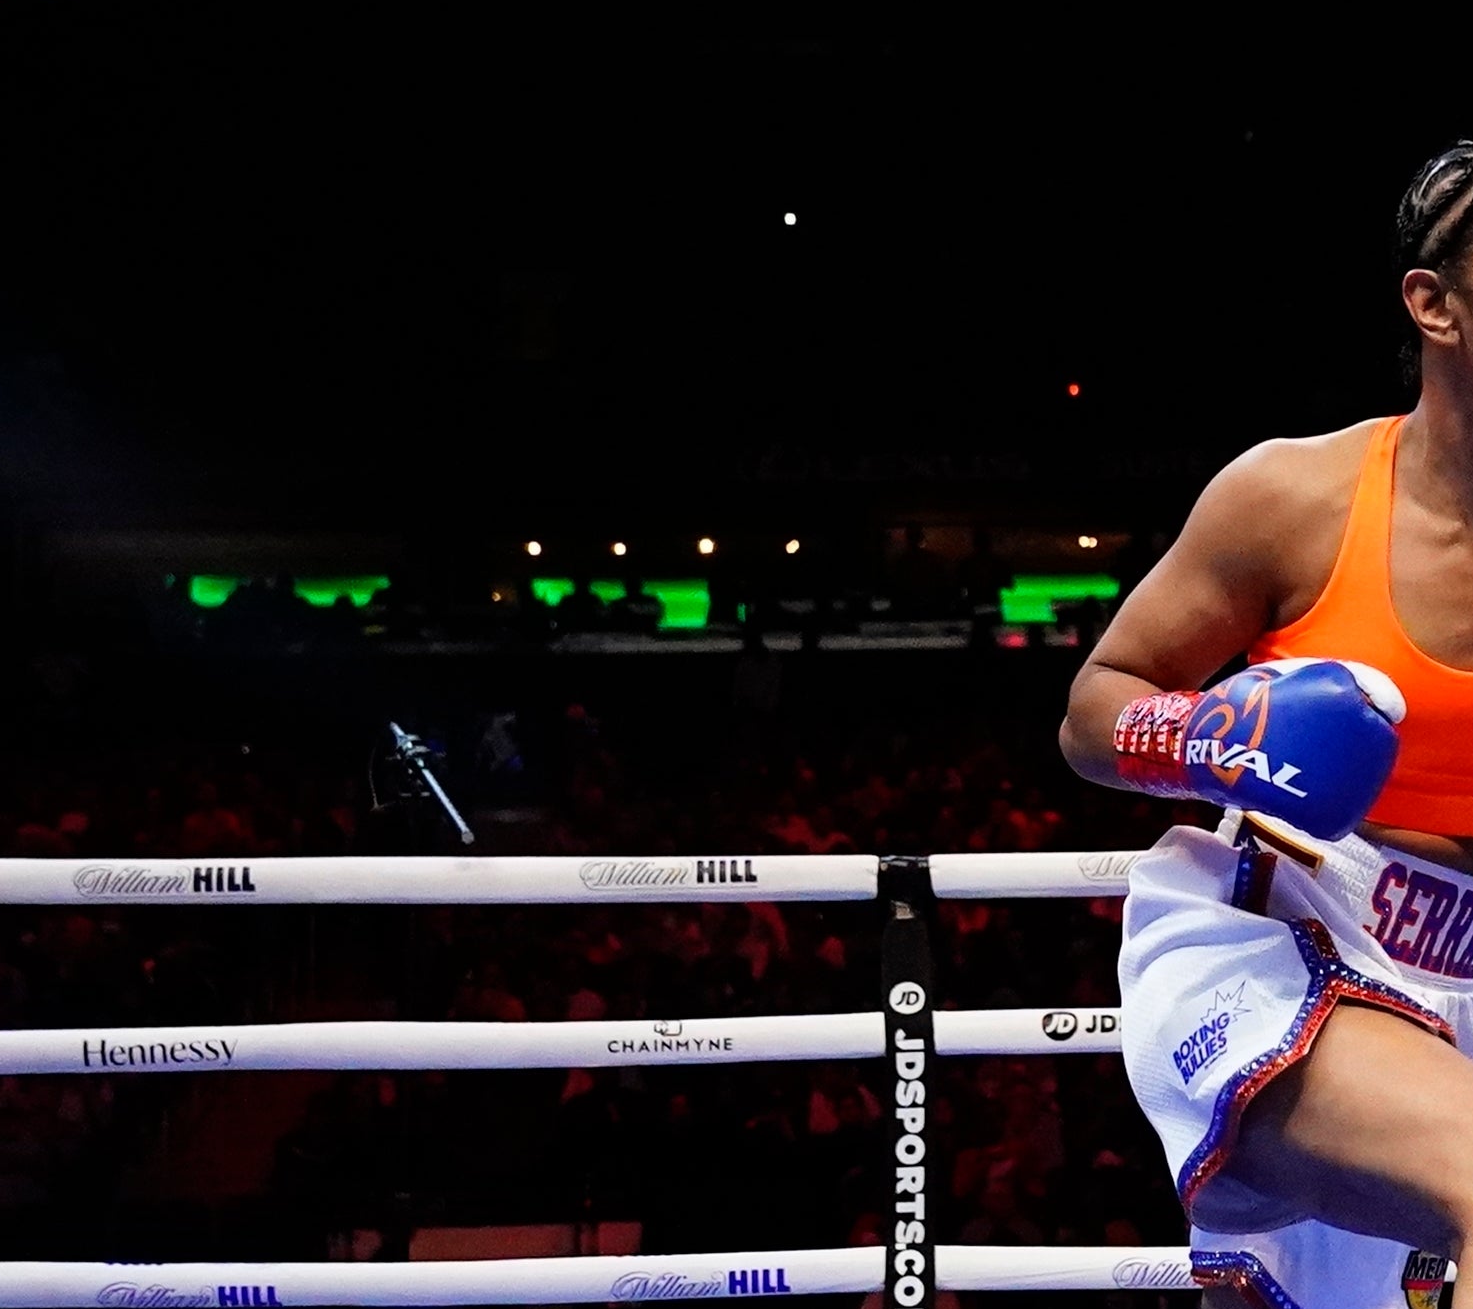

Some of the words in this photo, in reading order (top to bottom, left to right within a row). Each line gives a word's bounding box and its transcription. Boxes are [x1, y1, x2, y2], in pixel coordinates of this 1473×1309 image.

[1185, 737, 1308, 799] RIVAL
[73, 864, 192, 898] William
[193, 866, 256, 892] HILL
[579, 860, 693, 891] William
[696, 859, 758, 884] HILL
[82, 1039, 239, 1068] Hennessy
[607, 1037, 734, 1054] CHAINMYNE
[1173, 1012, 1230, 1070] BOXING
[1181, 1031, 1227, 1085] BULLIES
[217, 1285, 284, 1308] HILL
[610, 1270, 727, 1300] William
[728, 1267, 792, 1295] HILL
